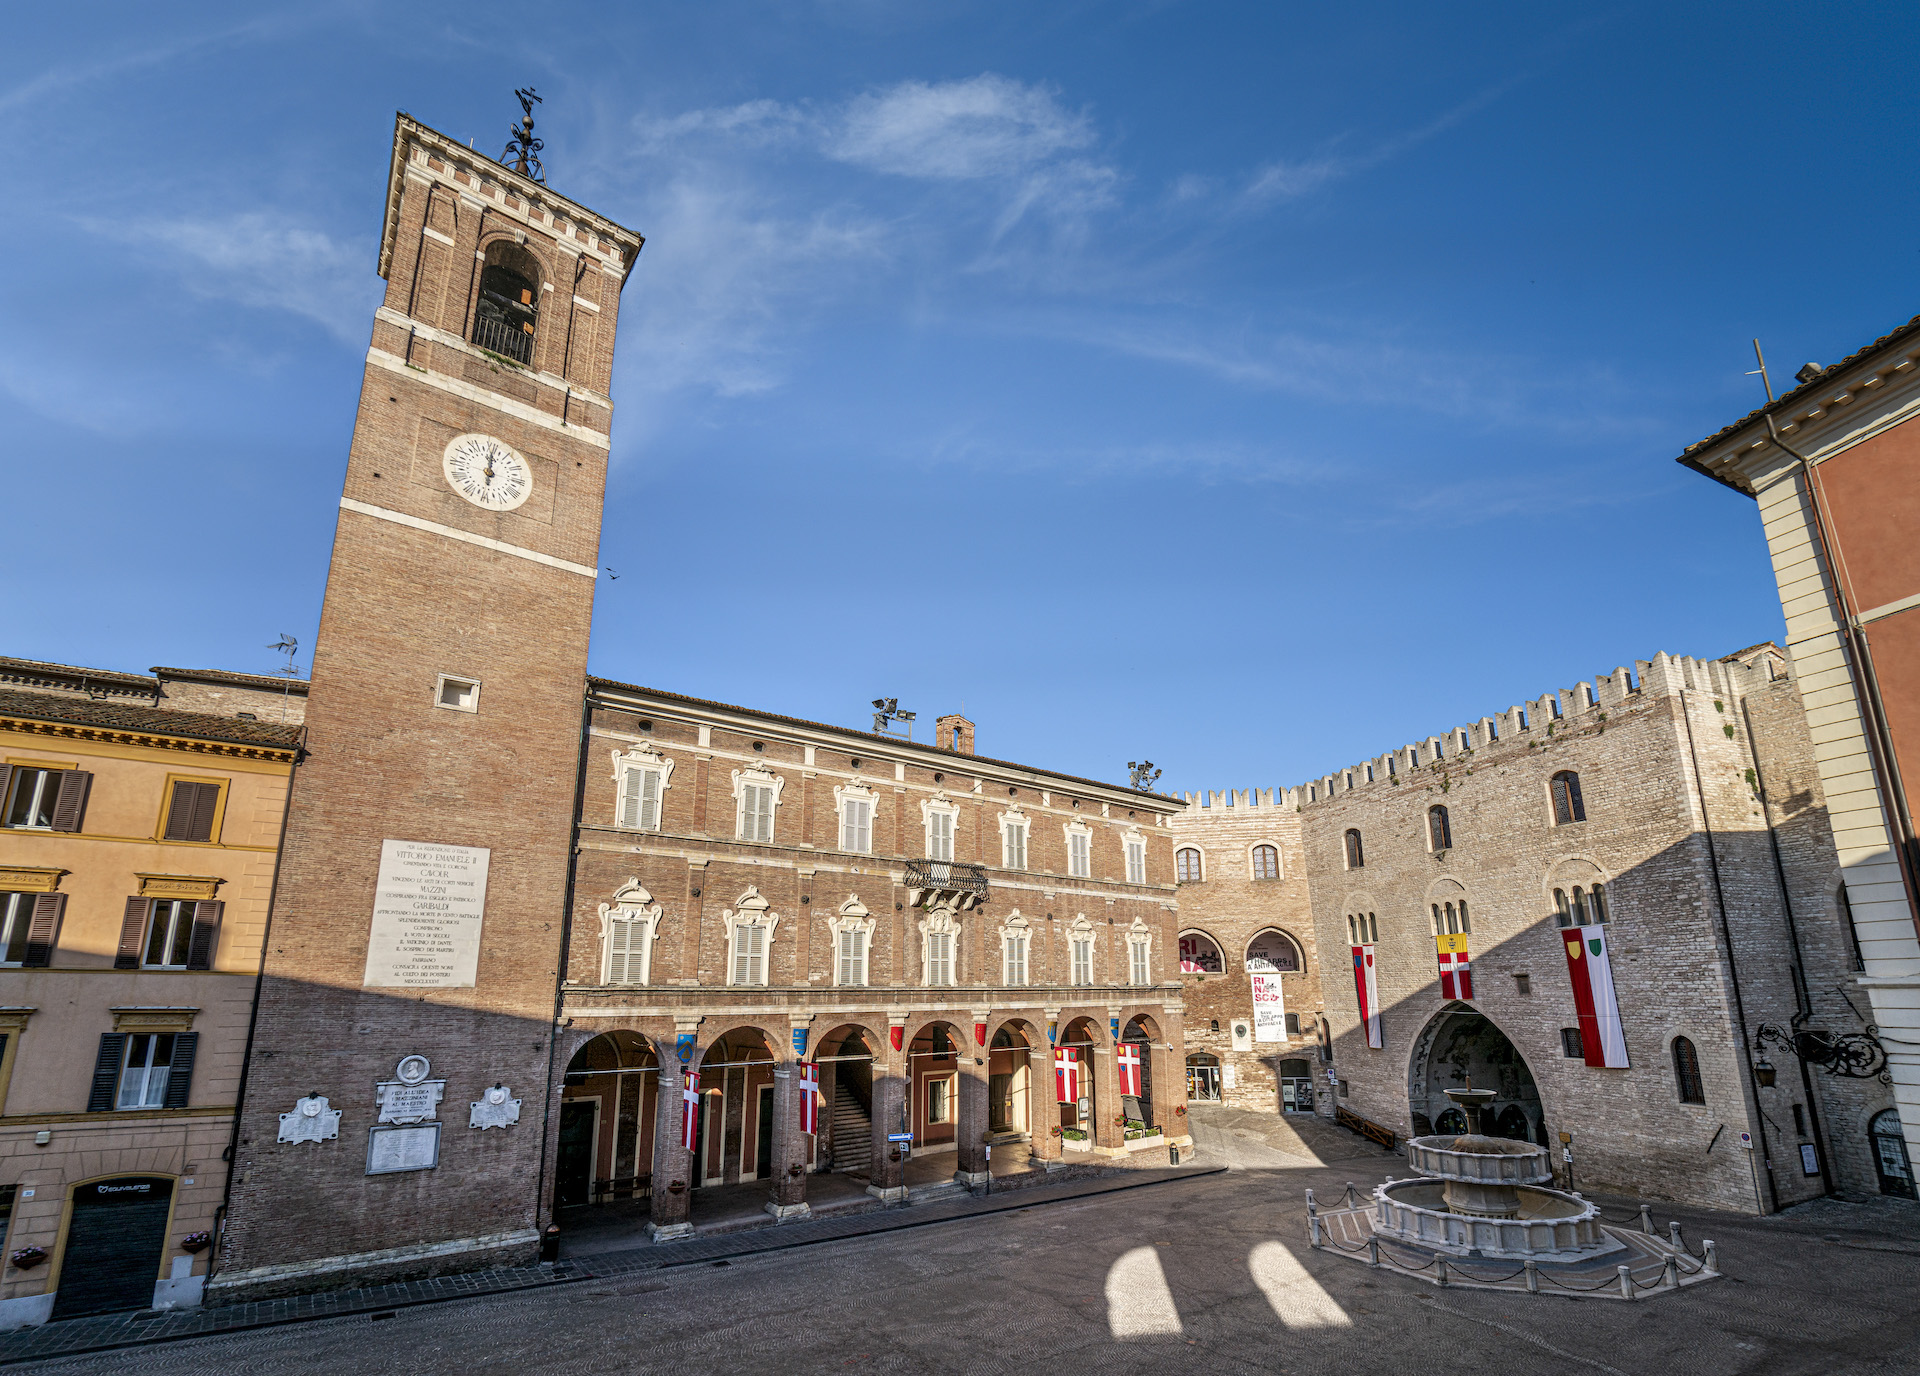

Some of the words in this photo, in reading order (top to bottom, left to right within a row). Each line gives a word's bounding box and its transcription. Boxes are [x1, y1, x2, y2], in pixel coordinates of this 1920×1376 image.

[397, 851, 432, 860] VITTORIO
[436, 854, 470, 863] EMANUELE
[413, 902, 449, 910] GARIBALDI
[1179, 940, 1196, 954] RI
